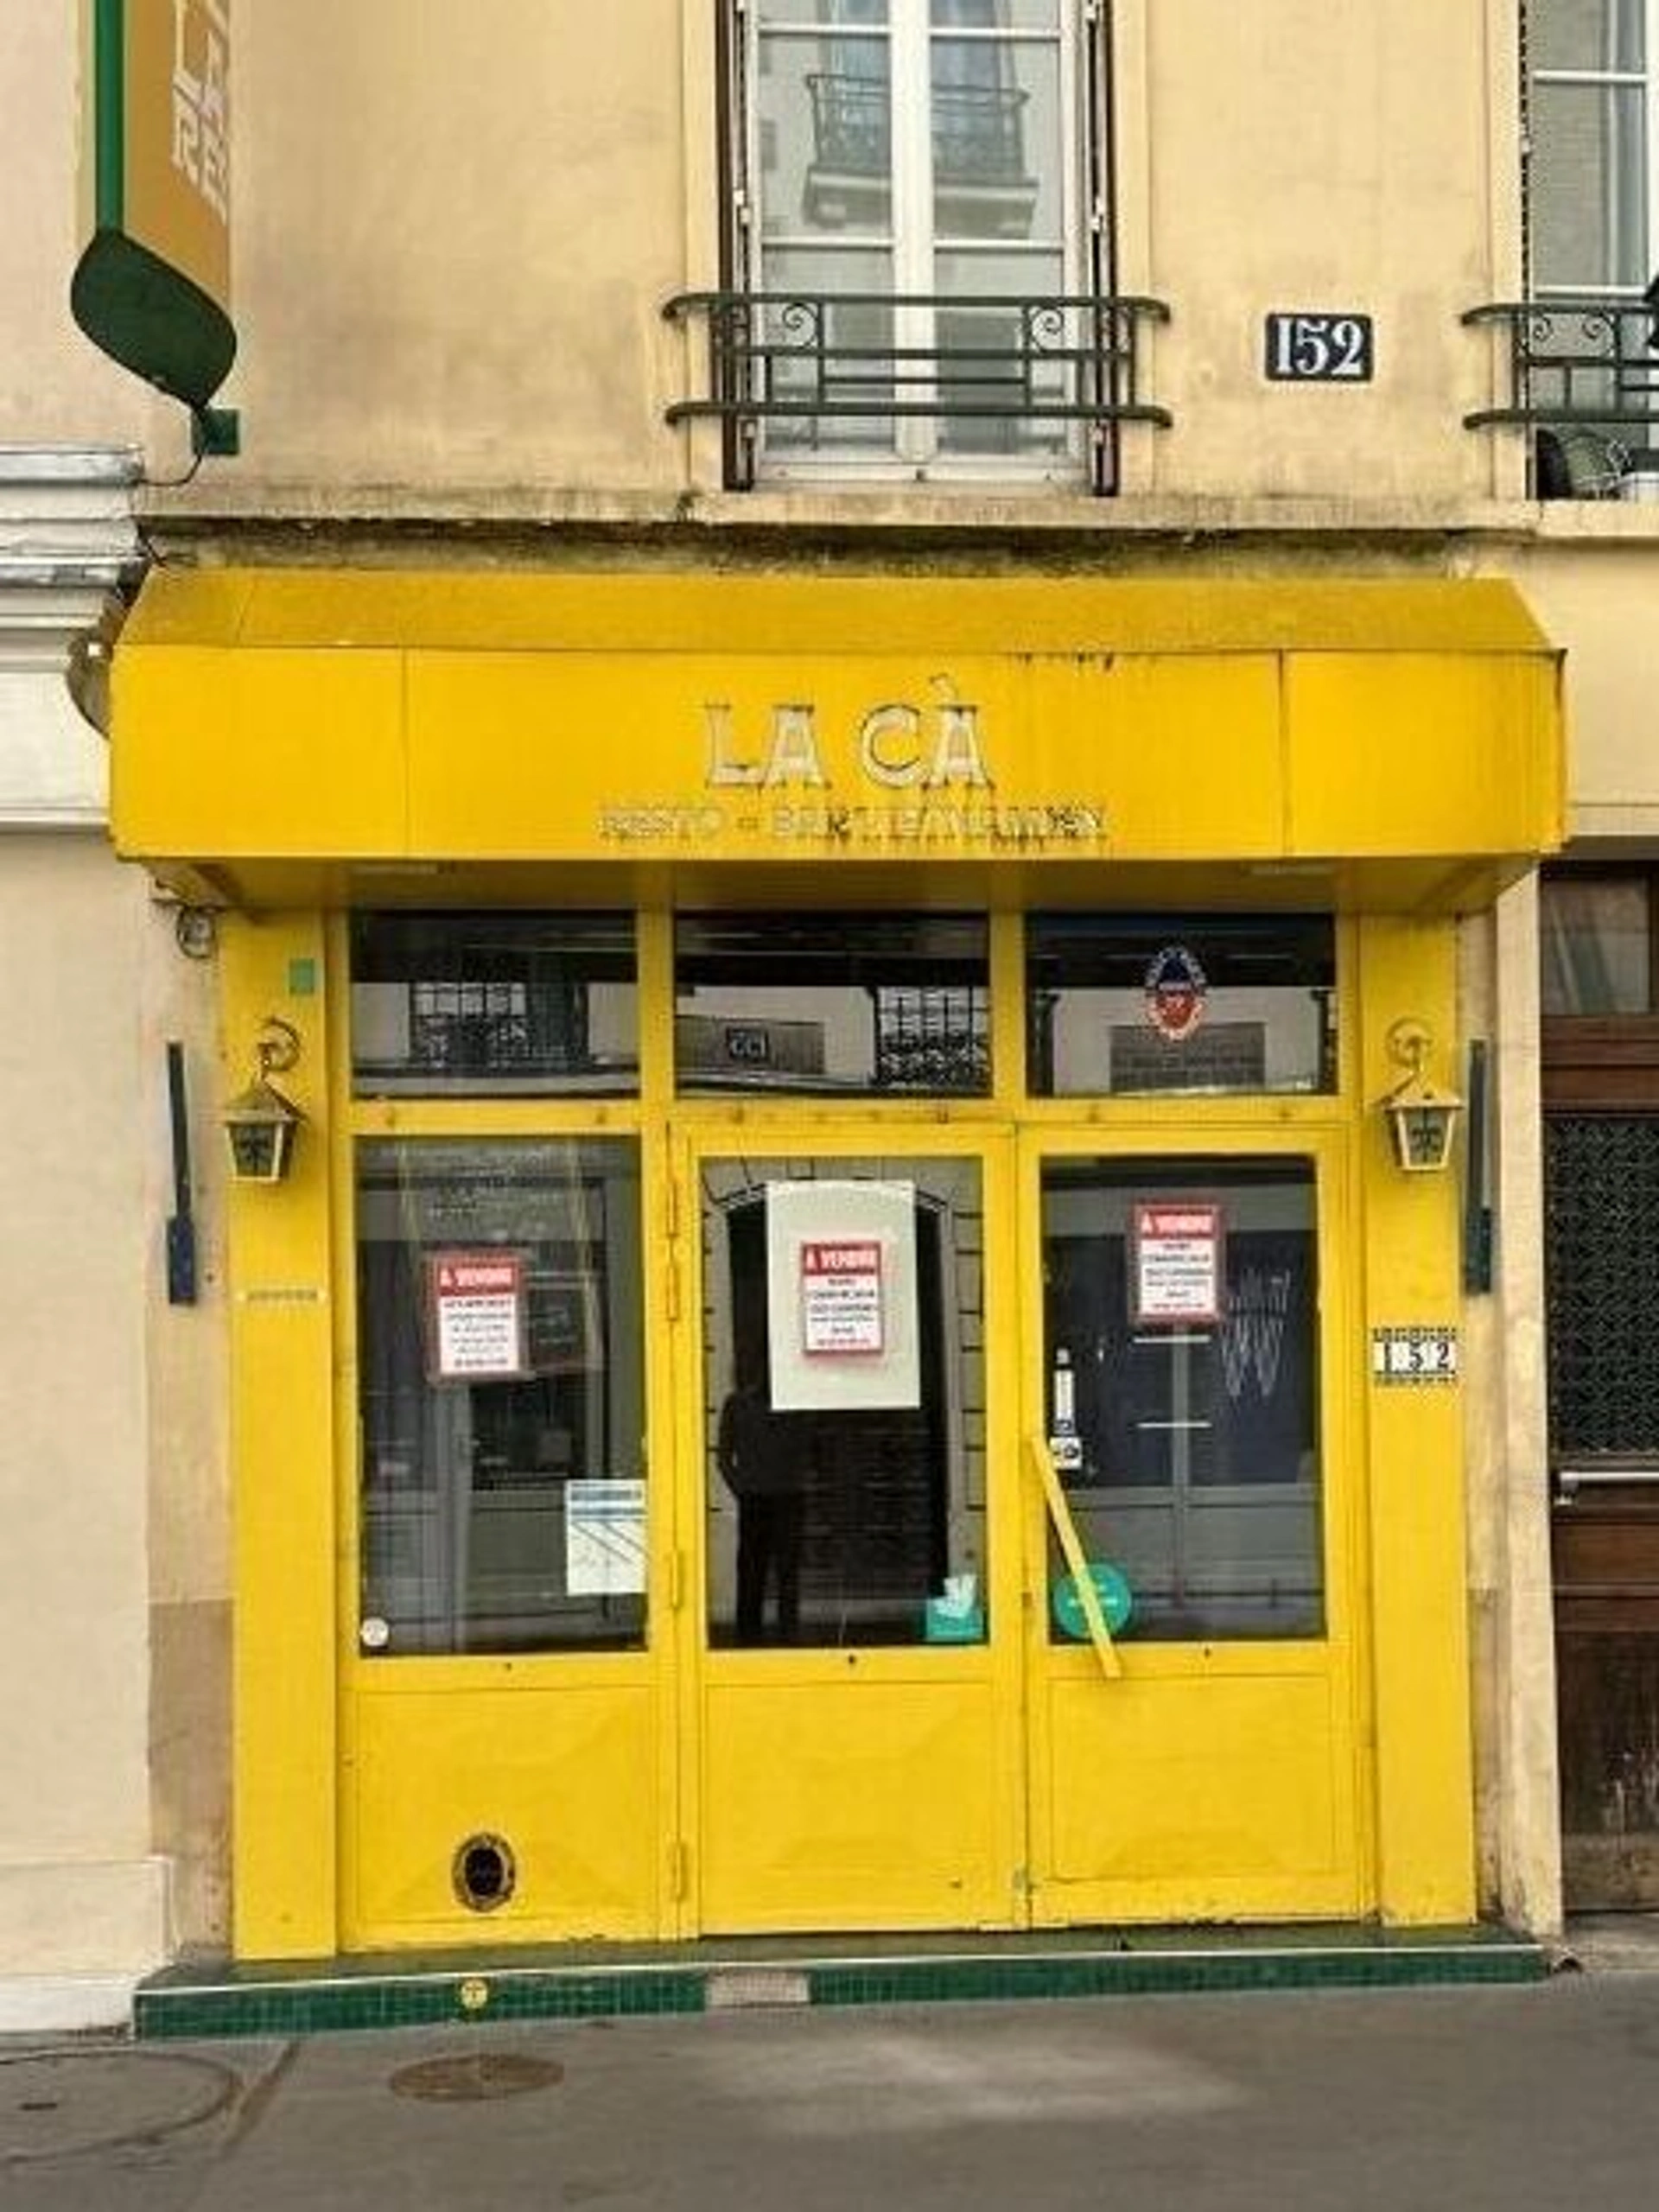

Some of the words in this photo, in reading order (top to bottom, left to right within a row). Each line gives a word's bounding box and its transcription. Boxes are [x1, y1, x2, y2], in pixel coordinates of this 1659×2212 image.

[1274, 318, 1363, 376] 152
[704, 703, 831, 790] LA
[860, 674, 996, 791] CÀ
[1382, 1342, 1450, 1372] 152
